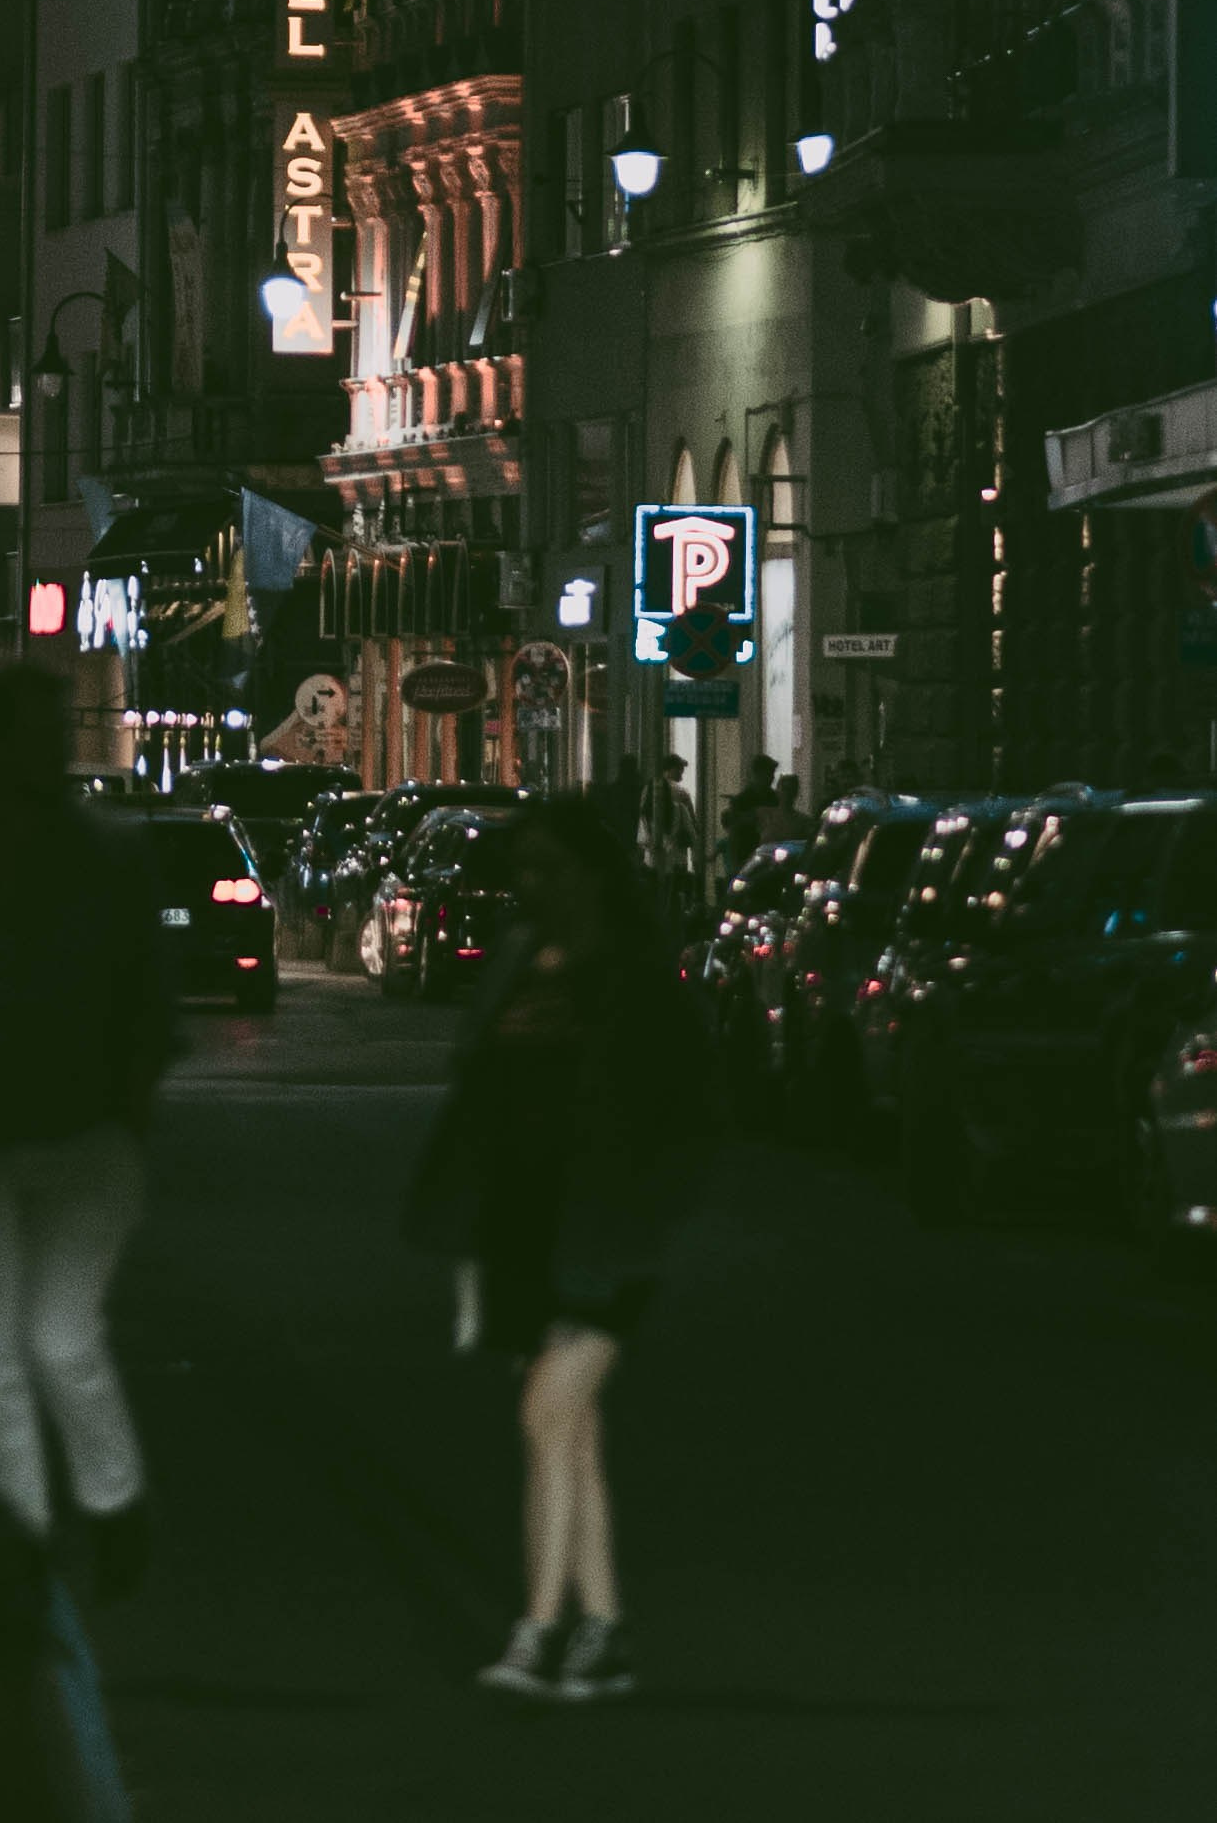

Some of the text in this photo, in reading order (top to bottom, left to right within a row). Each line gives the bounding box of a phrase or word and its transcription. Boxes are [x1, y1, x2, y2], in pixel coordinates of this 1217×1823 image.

[282, 113, 325, 341] ASTRA
[828, 639, 891, 652] HOTEL ART
